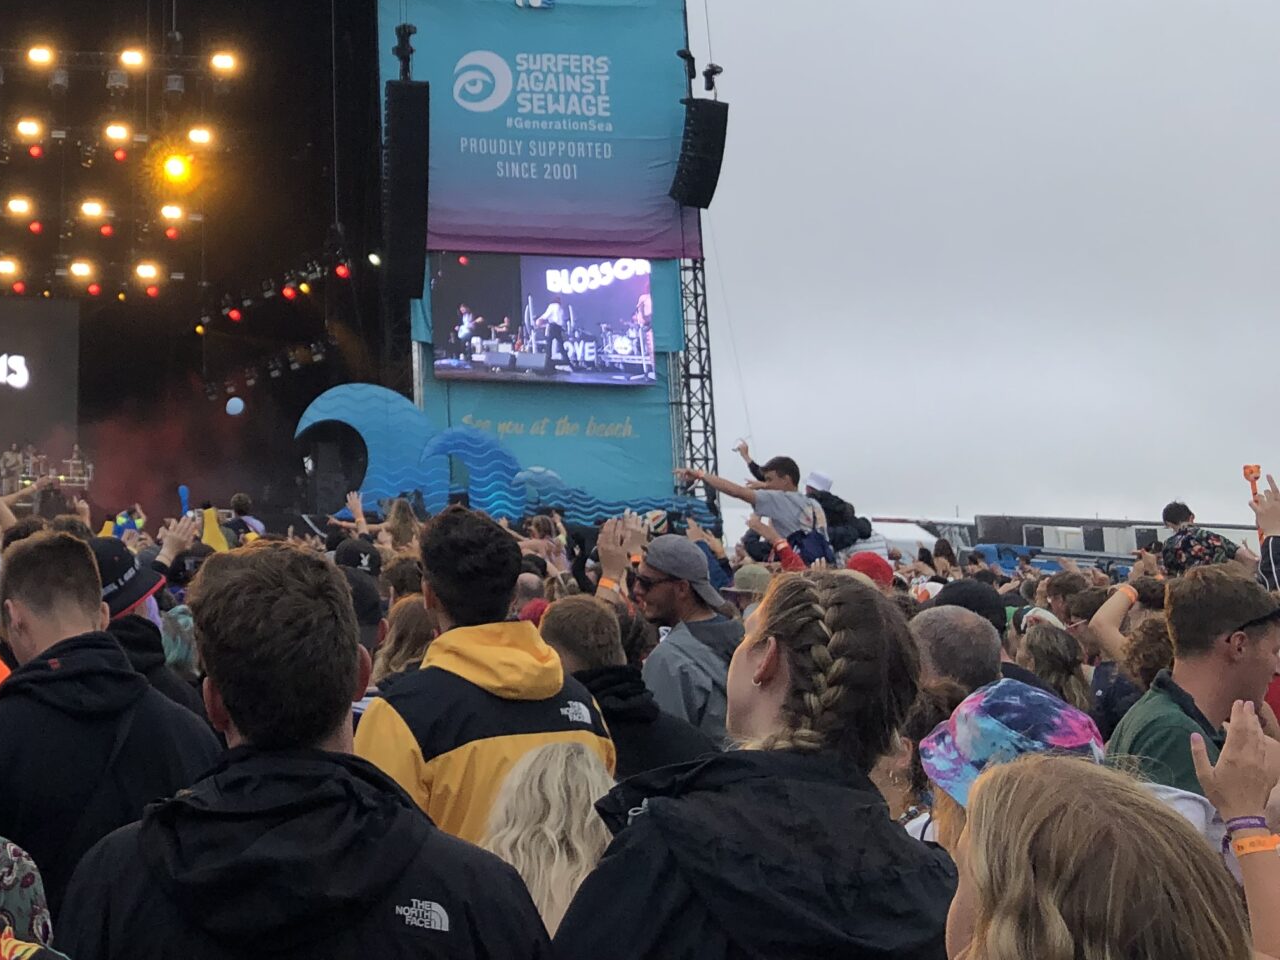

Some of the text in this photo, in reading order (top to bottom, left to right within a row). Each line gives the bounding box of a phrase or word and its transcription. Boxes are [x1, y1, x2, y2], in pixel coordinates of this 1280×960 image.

[516, 53, 609, 74] SURFERS
[516, 72, 610, 95] AGAINST
[517, 93, 611, 117] SEWAGE
[506, 117, 613, 132] #GenerationSea
[460, 137, 613, 159] PROUDLY SUPPORTED
[496, 161, 577, 179] SINCE 2001
[530, 417, 550, 436] at
[555, 415, 579, 437] the
[395, 905, 431, 920] NORTH
[411, 899, 432, 910] THE
[405, 916, 431, 929] FACE
